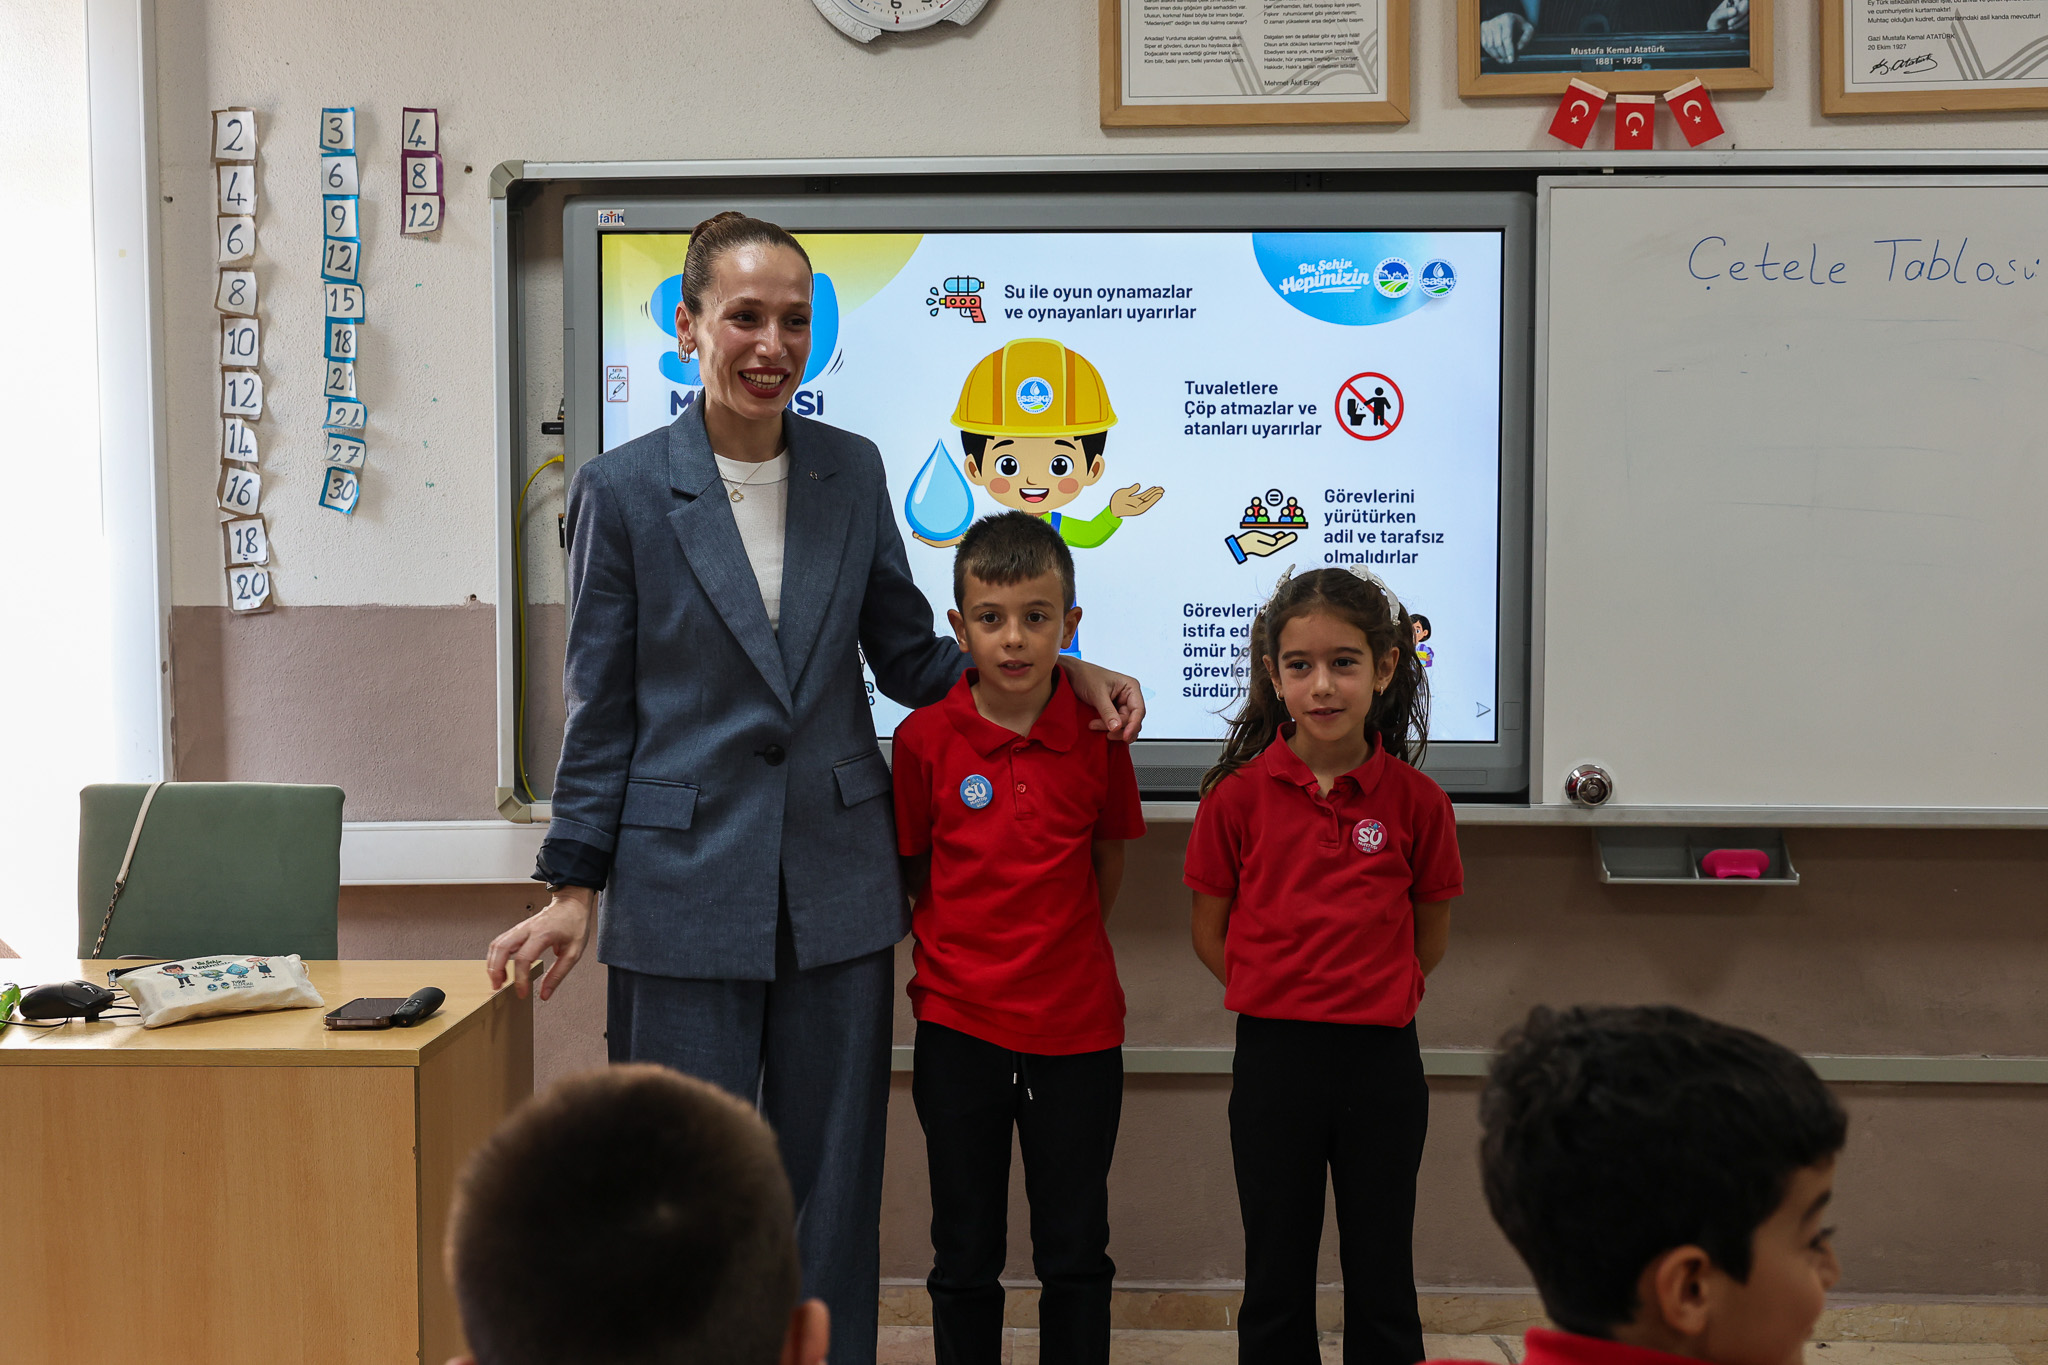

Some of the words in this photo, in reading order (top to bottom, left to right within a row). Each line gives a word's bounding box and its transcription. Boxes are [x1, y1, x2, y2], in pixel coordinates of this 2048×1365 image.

[1867, 17, 1889, 25] Muhtaç
[1891, 16, 1914, 25] olduğun
[1915, 16, 1935, 24] kudret,
[1876, 7, 1914, 16] cumhuriyetini
[1915, 6, 1951, 14] kurtarmaktır!
[1571, 46, 1604, 55] Mustafa
[1606, 46, 1632, 54] Kemal
[1634, 45, 1665, 53] Atatürk
[1595, 57, 1614, 65] 1881
[1623, 57, 1642, 65] 1938
[223, 118, 244, 152] 2
[328, 117, 344, 144] 3
[408, 119, 427, 148] 4
[328, 163, 344, 188] 6
[412, 163, 427, 189] 8
[227, 172, 247, 206] 4
[331, 205, 346, 232] 9
[409, 202, 435, 228] 12
[227, 224, 244, 254] 6
[327, 244, 352, 272] 12
[1298, 263, 1316, 275] Bu
[1318, 258, 1353, 271] Şehir
[1688, 236, 1847, 291] Çetele
[228, 279, 246, 306] 8
[1279, 268, 1370, 295] Hepimizin
[330, 288, 355, 312] 15
[1004, 285, 1025, 299] Su
[1029, 285, 1049, 299] ile
[1052, 287, 1093, 304] oyun
[1096, 285, 1193, 304] oynamazlar
[1004, 308, 1023, 319] ve
[1027, 305, 1123, 323] oynayanları
[1126, 305, 1196, 323] uyarırlar
[228, 328, 255, 356] 10
[334, 329, 352, 353] 18
[329, 368, 354, 391] 21
[1184, 381, 1278, 395] Tuvaletlere
[228, 378, 257, 408] 12
[1184, 401, 1217, 418] Çöp
[1220, 401, 1294, 415] atmazlar
[1298, 404, 1317, 415] ve
[229, 424, 252, 456] 14
[1184, 422, 1248, 435] atanları
[1252, 422, 1322, 439] uyarırlar
[327, 444, 361, 464] 27
[226, 475, 251, 506] 16
[328, 479, 355, 501] 30
[1324, 489, 1415, 504] Görevlerini
[1324, 509, 1416, 527] yürütürken
[235, 526, 258, 555] 18
[1324, 529, 1353, 544] adil
[1357, 533, 1377, 544] ve
[1380, 529, 1444, 544] tarafsız
[1324, 550, 1418, 564] olmalıdırlar
[237, 572, 266, 601] 20
[1183, 623, 1225, 637] istifa
[1230, 624, 1250, 637] ed
[1183, 643, 1226, 657] ömür
[1231, 644, 1251, 657] bo
[1183, 663, 1251, 681] görevler
[1183, 683, 1250, 698] sürdürm
